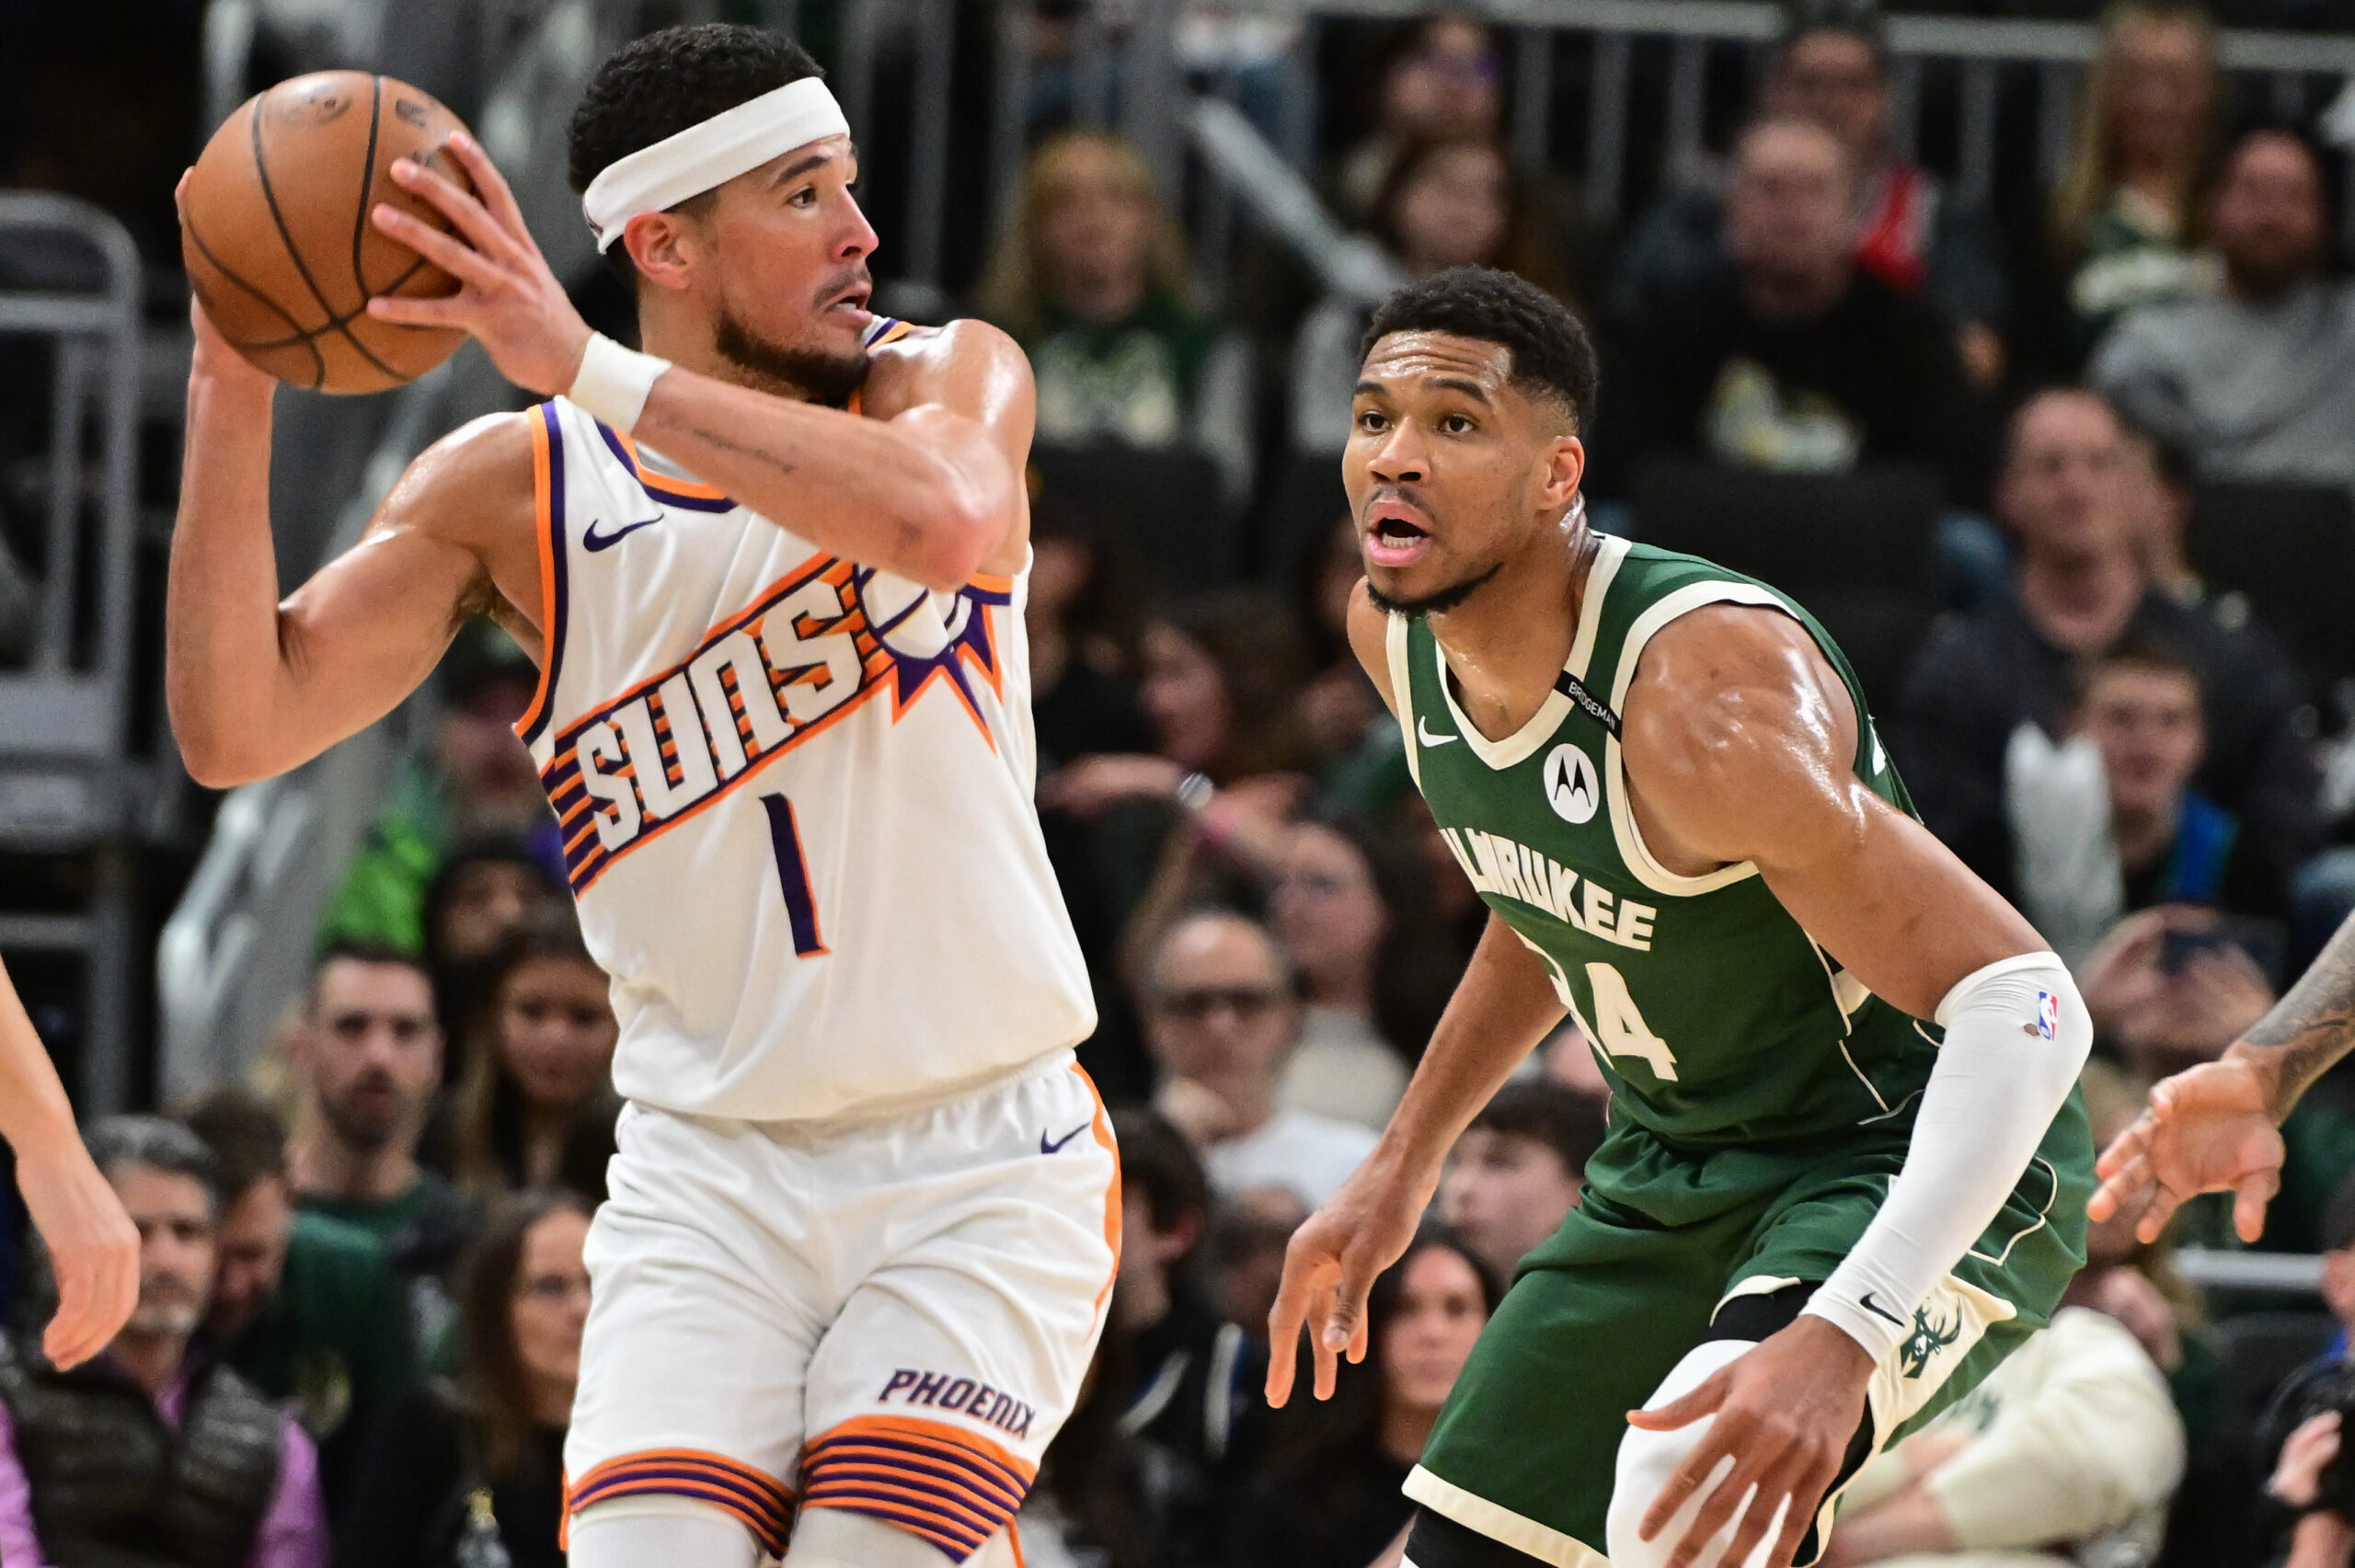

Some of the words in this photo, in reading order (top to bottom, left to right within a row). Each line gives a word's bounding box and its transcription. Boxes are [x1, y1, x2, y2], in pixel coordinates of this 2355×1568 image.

[576, 578, 863, 853] SUNS
[1568, 681, 1616, 732] BRIDGEMAN
[758, 791, 833, 959] 1
[1438, 827, 1657, 952] ILWAUKEE
[877, 1368, 1037, 1442] PHOENIX
